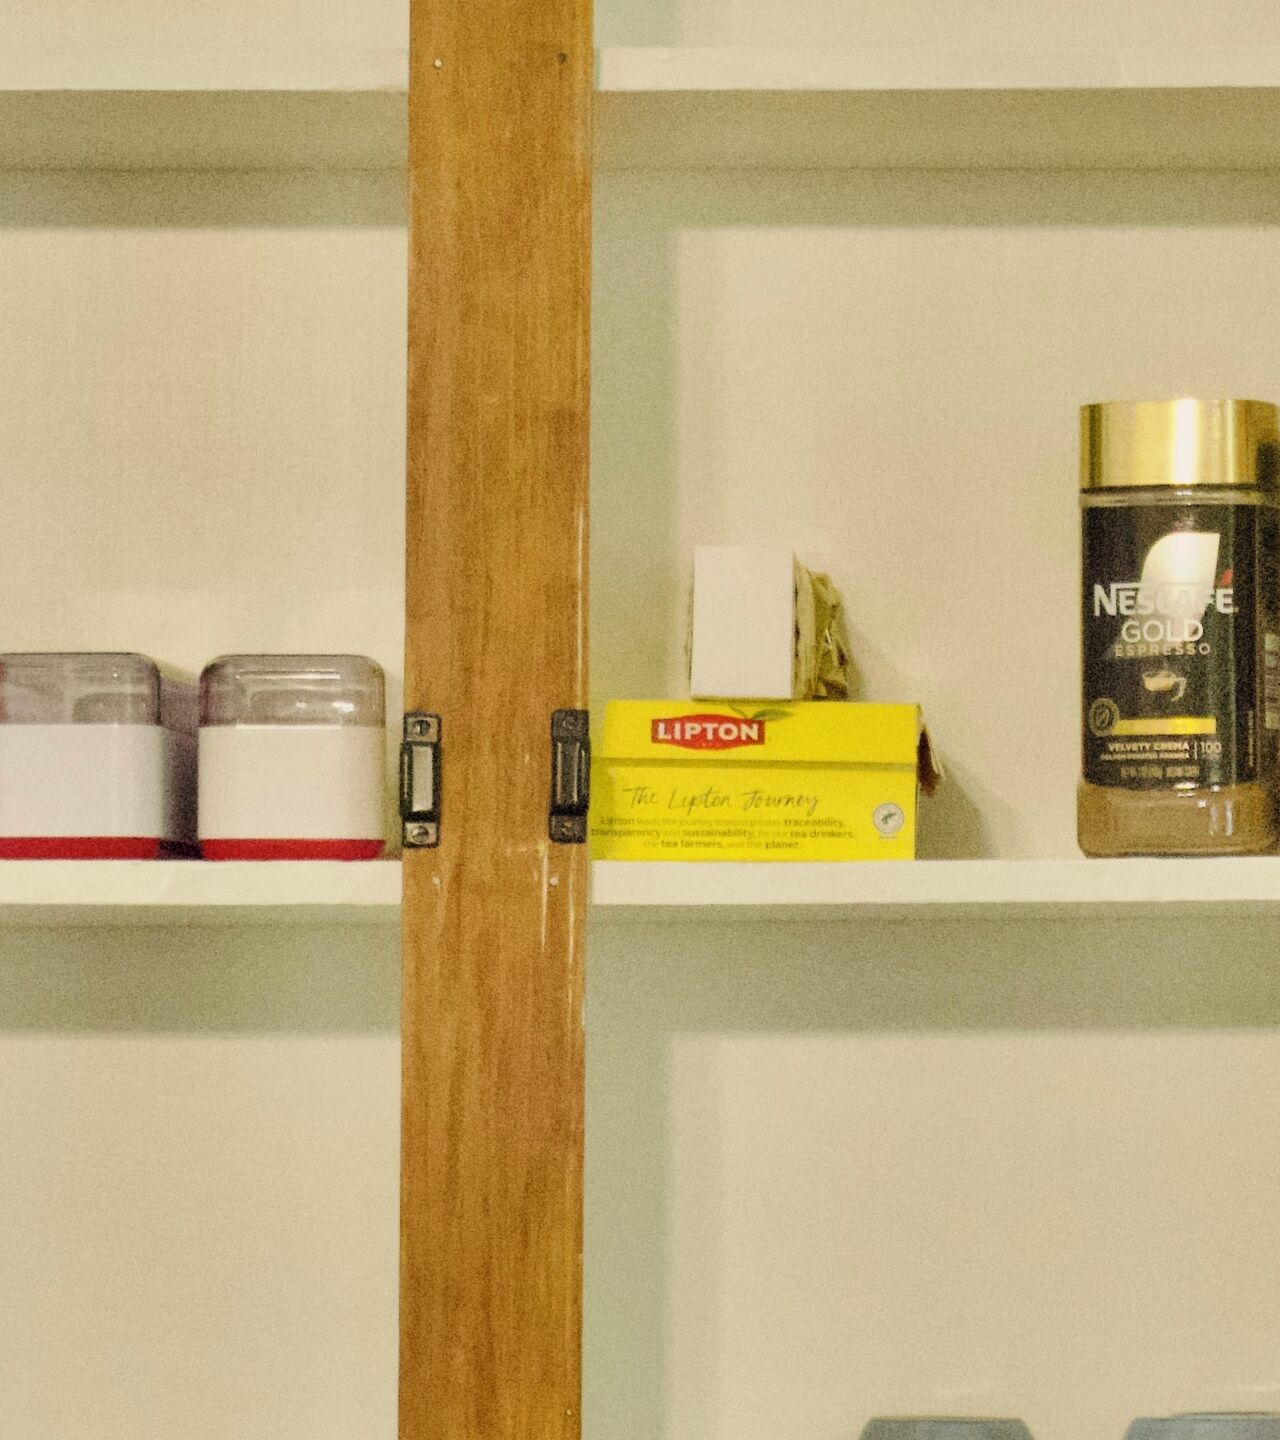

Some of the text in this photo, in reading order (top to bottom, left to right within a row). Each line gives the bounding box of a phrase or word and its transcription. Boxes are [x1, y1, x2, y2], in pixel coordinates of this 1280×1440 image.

[1121, 618, 1204, 643] GOLD
[1114, 642, 1211, 657] ESPRESSO
[657, 721, 759, 741] LIPTON
[622, 785, 818, 817] The Lipton Journey
